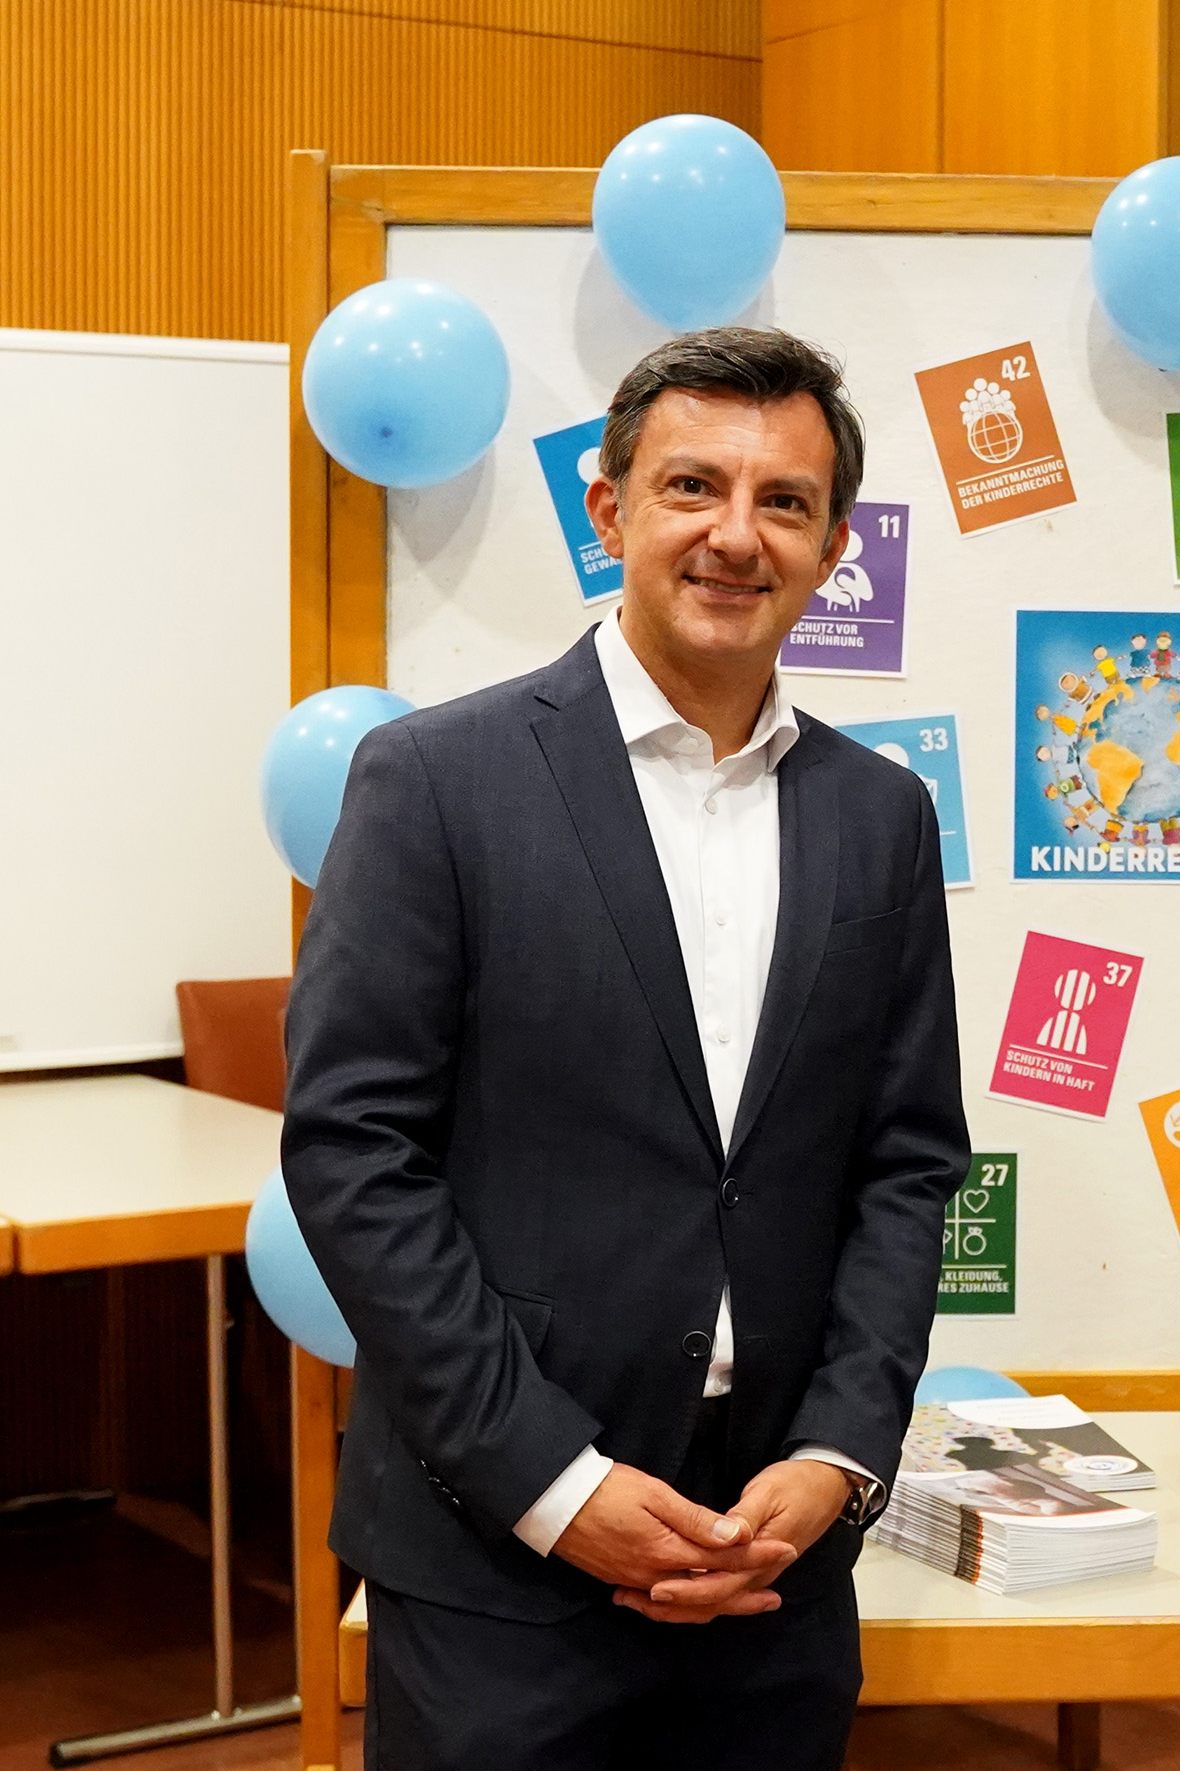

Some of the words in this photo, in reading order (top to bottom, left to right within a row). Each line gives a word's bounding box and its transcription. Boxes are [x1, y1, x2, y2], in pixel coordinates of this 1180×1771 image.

[1001, 355, 1031, 381] 42
[957, 459, 1065, 499] BEKANNTMACHUNG
[961, 494, 984, 510] DER
[984, 472, 1064, 504] KINDERRECHTE
[878, 514, 900, 538] 11
[583, 557, 622, 575] GEWA
[789, 632, 865, 648] ENTFÜHRUNG
[835, 623, 858, 635] VOR
[919, 727, 949, 752] 33
[1102, 961, 1133, 988] 37
[1006, 1050, 1050, 1069] SCHUTZ
[1049, 1060, 1073, 1075] VON
[1003, 1061, 1051, 1082] KINDERN
[1052, 1073, 1065, 1086] IN
[1066, 1076, 1095, 1092] HAFT
[981, 1163, 1009, 1187] 27
[945, 1270, 1003, 1282] KLEIDUNG,
[959, 1282, 1009, 1293] ZUHAUSE
